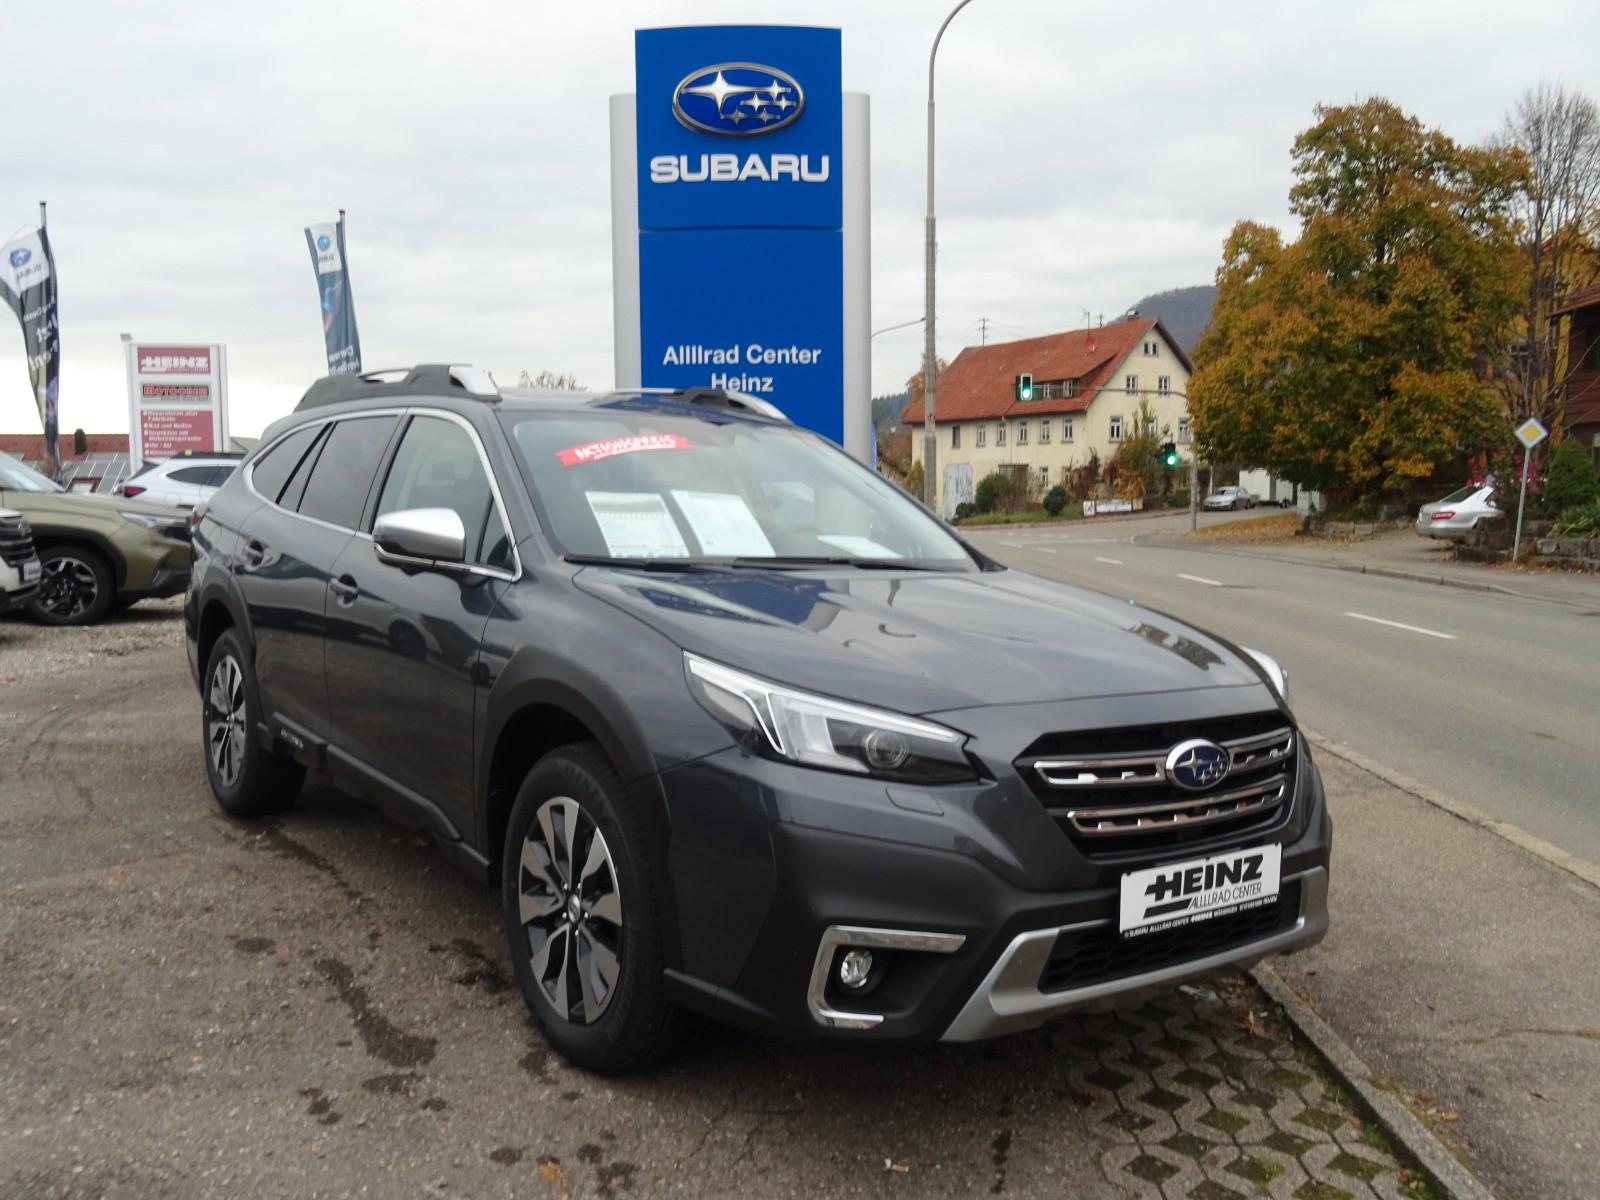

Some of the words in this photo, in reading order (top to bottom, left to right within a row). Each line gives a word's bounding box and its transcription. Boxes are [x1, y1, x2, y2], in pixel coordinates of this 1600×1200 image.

[650, 154, 829, 183] SUBARU
[141, 356, 208, 368] HEINZ
[746, 344, 822, 365] Center
[711, 372, 774, 392] Heinz
[1144, 854, 1263, 902] HEINZ
[1233, 883, 1262, 901] CENTER
